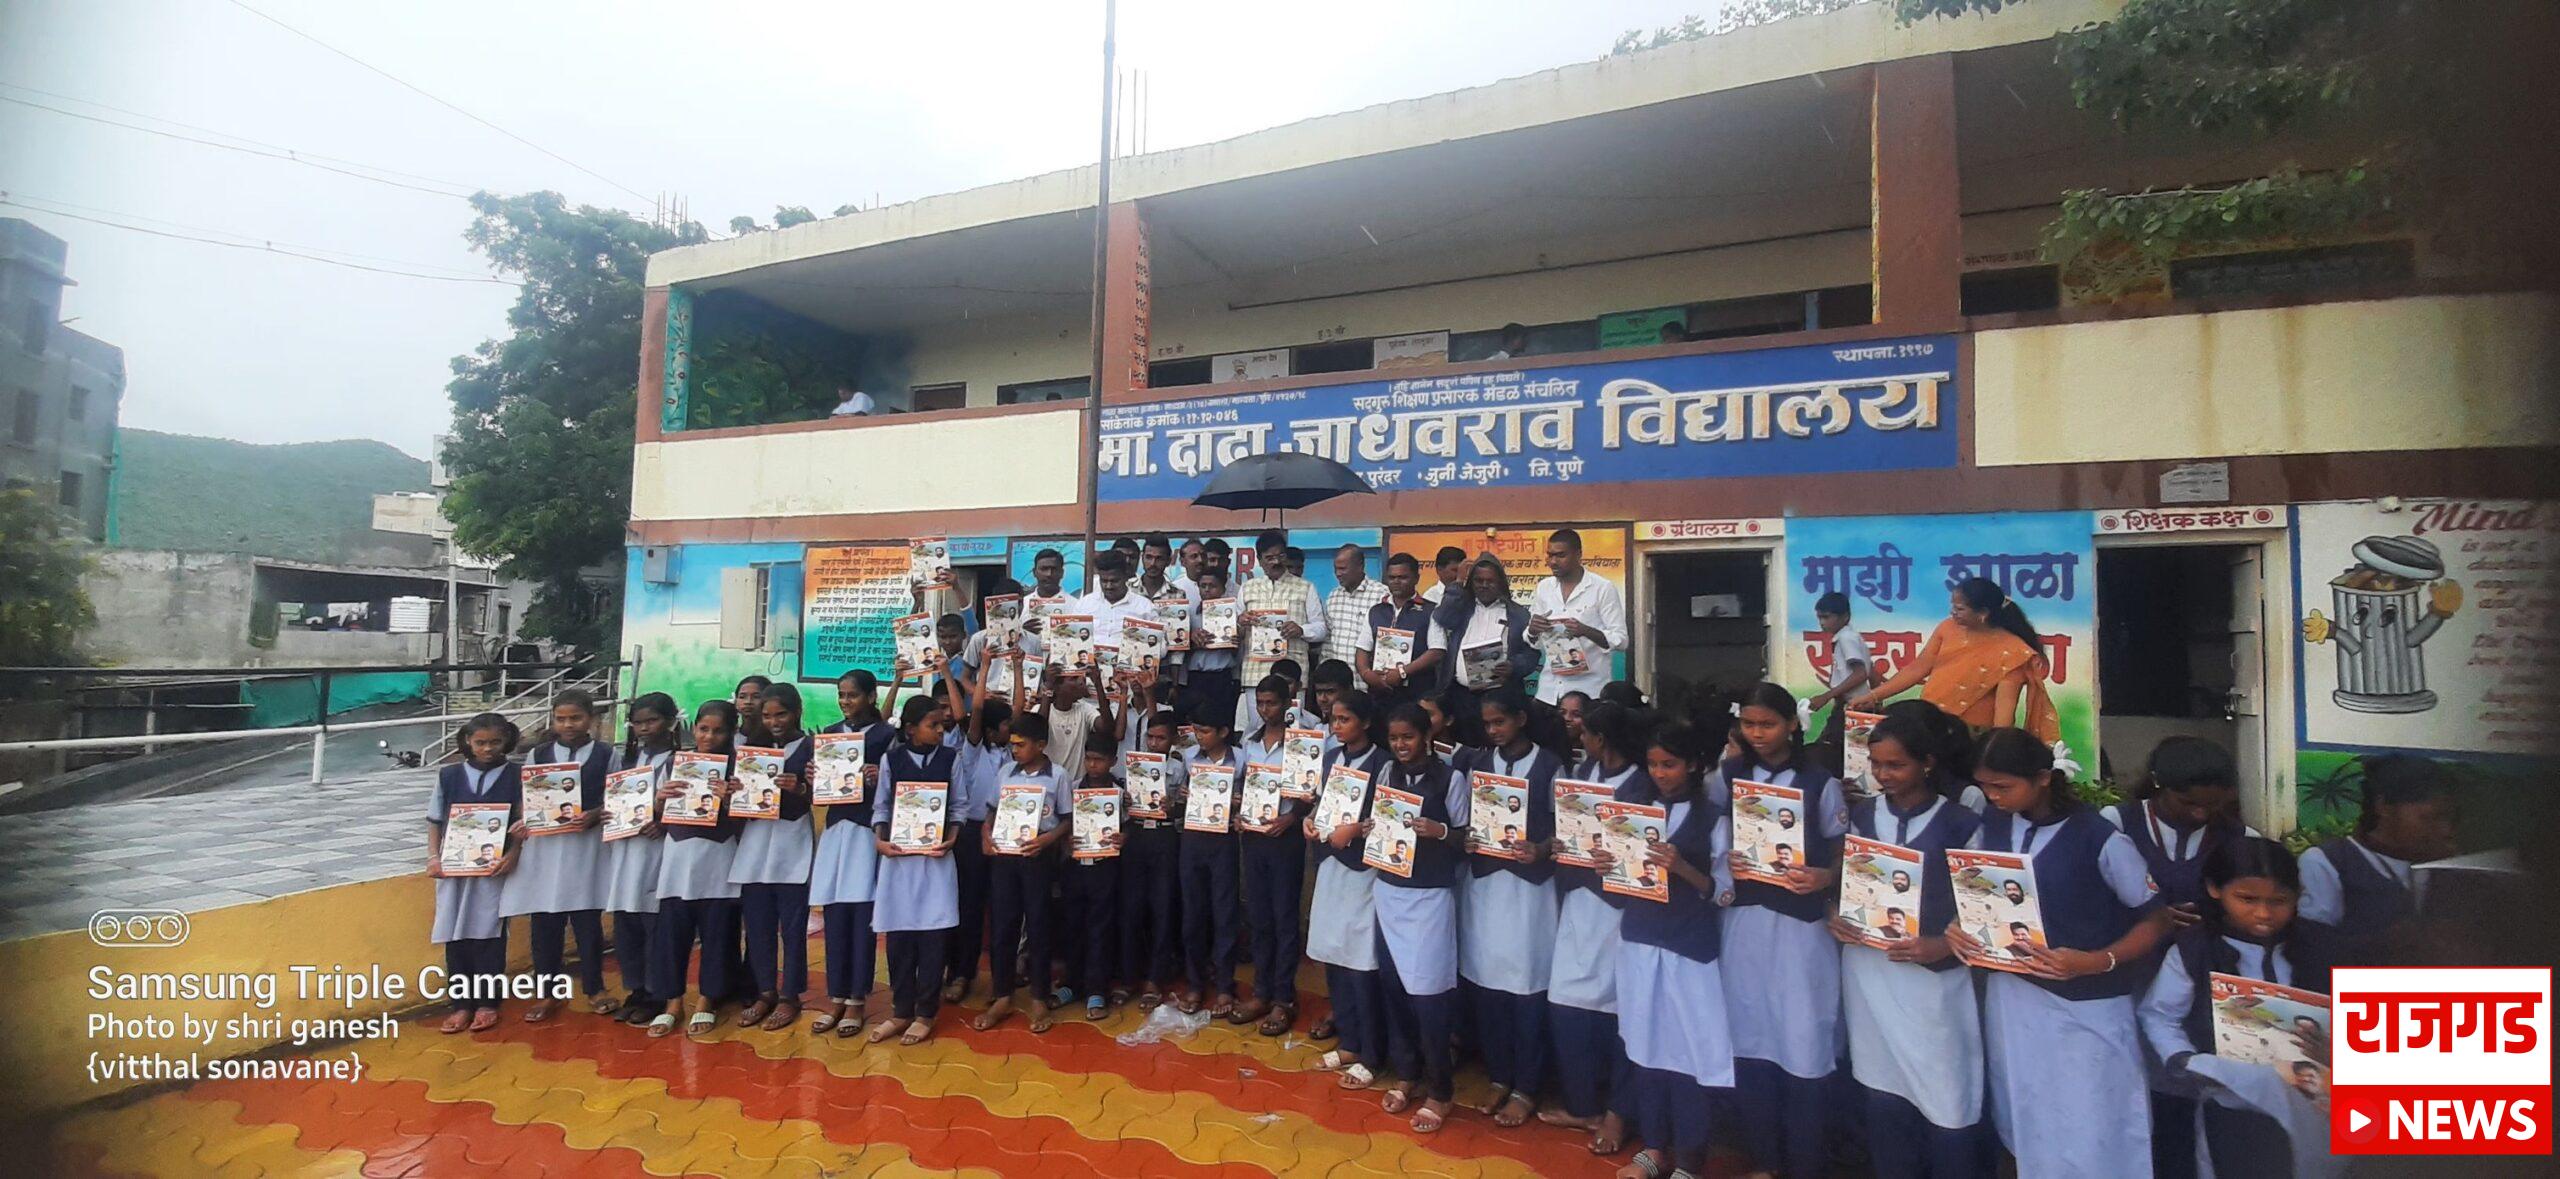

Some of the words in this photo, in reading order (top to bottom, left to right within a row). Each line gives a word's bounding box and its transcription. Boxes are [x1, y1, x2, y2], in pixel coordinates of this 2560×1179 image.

[1098, 430, 1158, 478] मा.
[1597, 371, 1950, 449] विद्यालय
[1670, 520, 1739, 537] ग्रंथालय
[2122, 509, 2196, 531] शिक्षक
[2197, 511, 2249, 527] कक्ष
[1801, 542, 1913, 613] माझी
